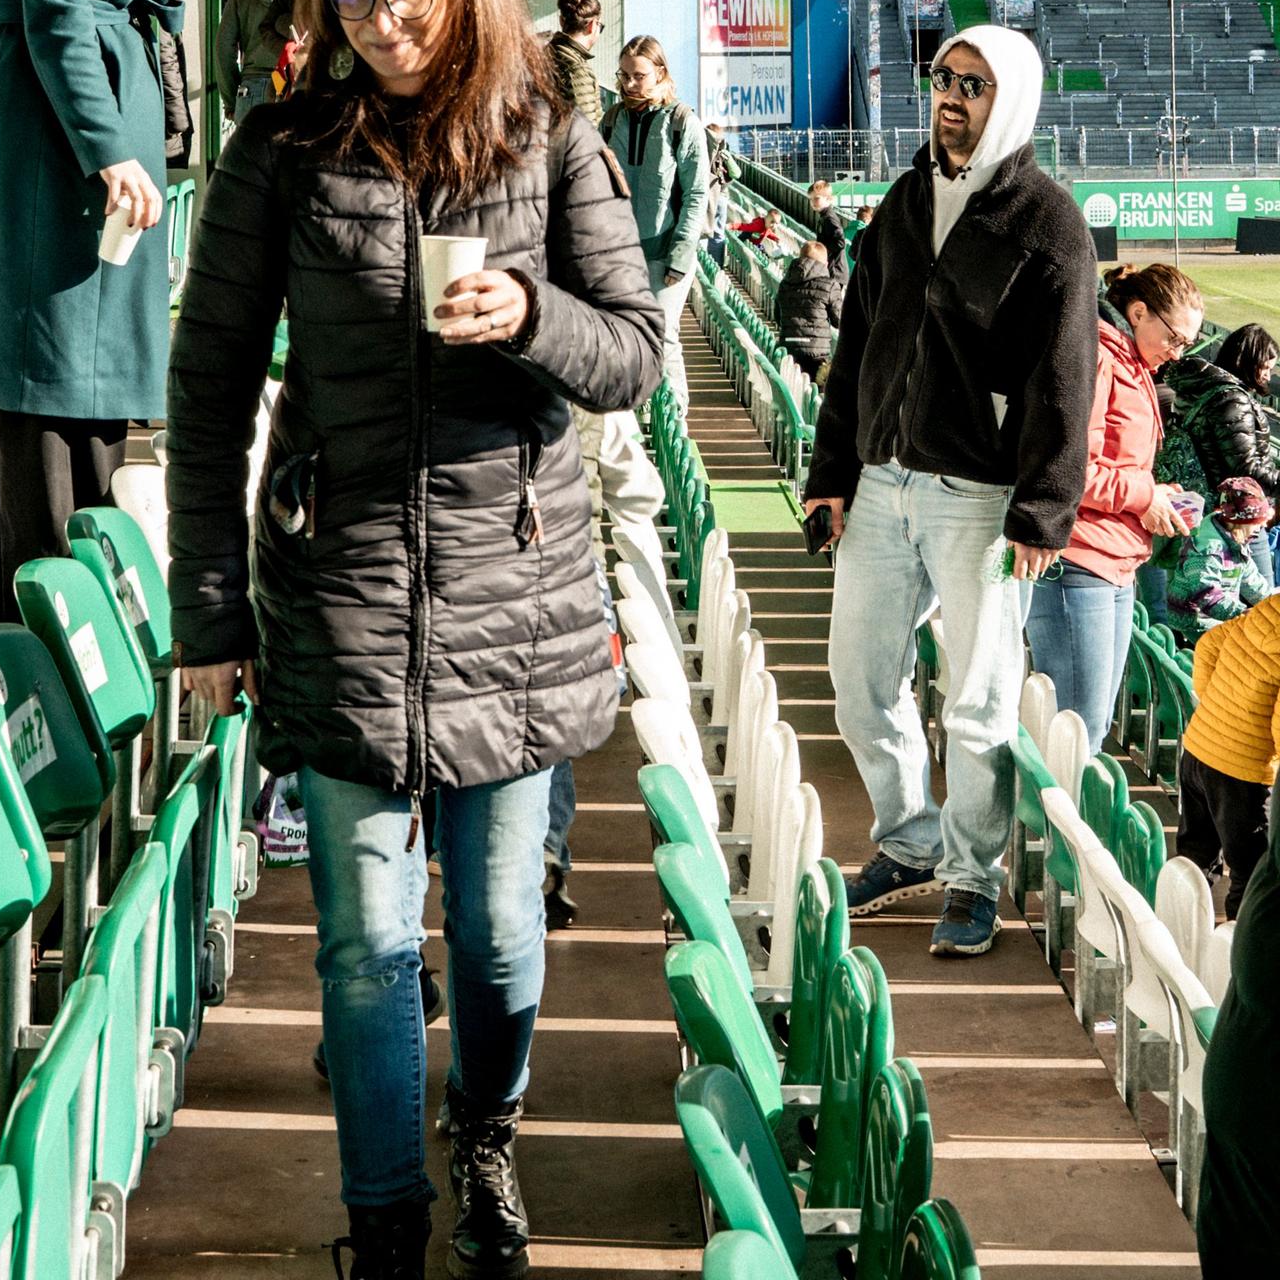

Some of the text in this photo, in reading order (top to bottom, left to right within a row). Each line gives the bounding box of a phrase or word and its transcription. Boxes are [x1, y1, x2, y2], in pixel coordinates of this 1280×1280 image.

[751, 63, 786, 80] Personal
[1119, 191, 1213, 209] FRANKEN
[1119, 210, 1213, 227] BRUNNEN
